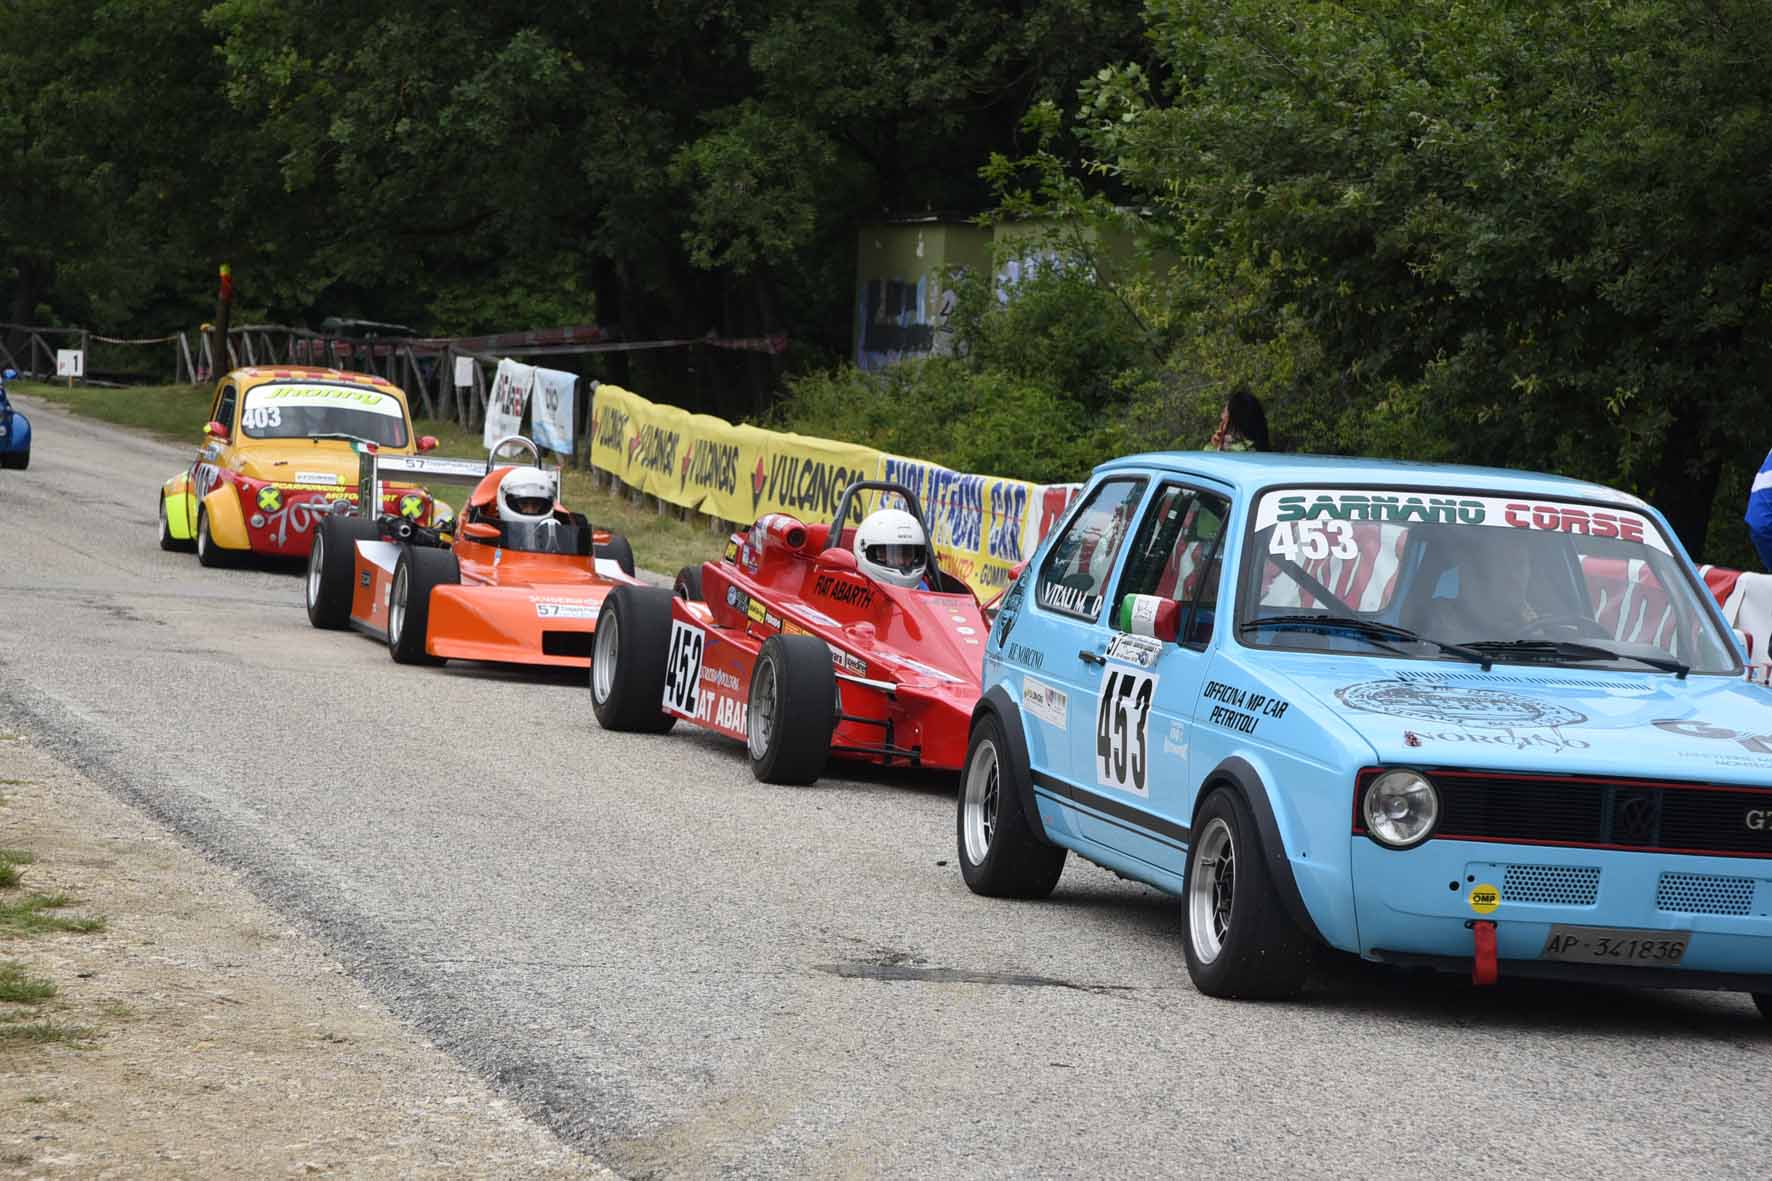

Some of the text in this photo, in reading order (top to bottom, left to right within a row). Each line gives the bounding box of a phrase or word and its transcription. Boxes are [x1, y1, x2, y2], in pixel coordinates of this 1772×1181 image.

[242, 407, 281, 429] 403
[405, 459, 425, 469] 57
[767, 453, 865, 525] VULCANGAS
[989, 480, 1026, 562] CAR
[1276, 495, 1645, 542] SARNANO CORSE
[1268, 519, 1359, 561] 453
[815, 575, 873, 608] FIAT ABARTH
[1044, 581, 1077, 609] VITALI
[538, 605, 560, 616] 57
[666, 626, 701, 713] 452
[1203, 680, 1288, 719] OFFICINA MP CAR
[1097, 671, 1152, 789] 453
[1209, 706, 1258, 734] PETRITOLI
[1472, 893, 1497, 905] OMP
[1546, 934, 1685, 960] AP 341836
